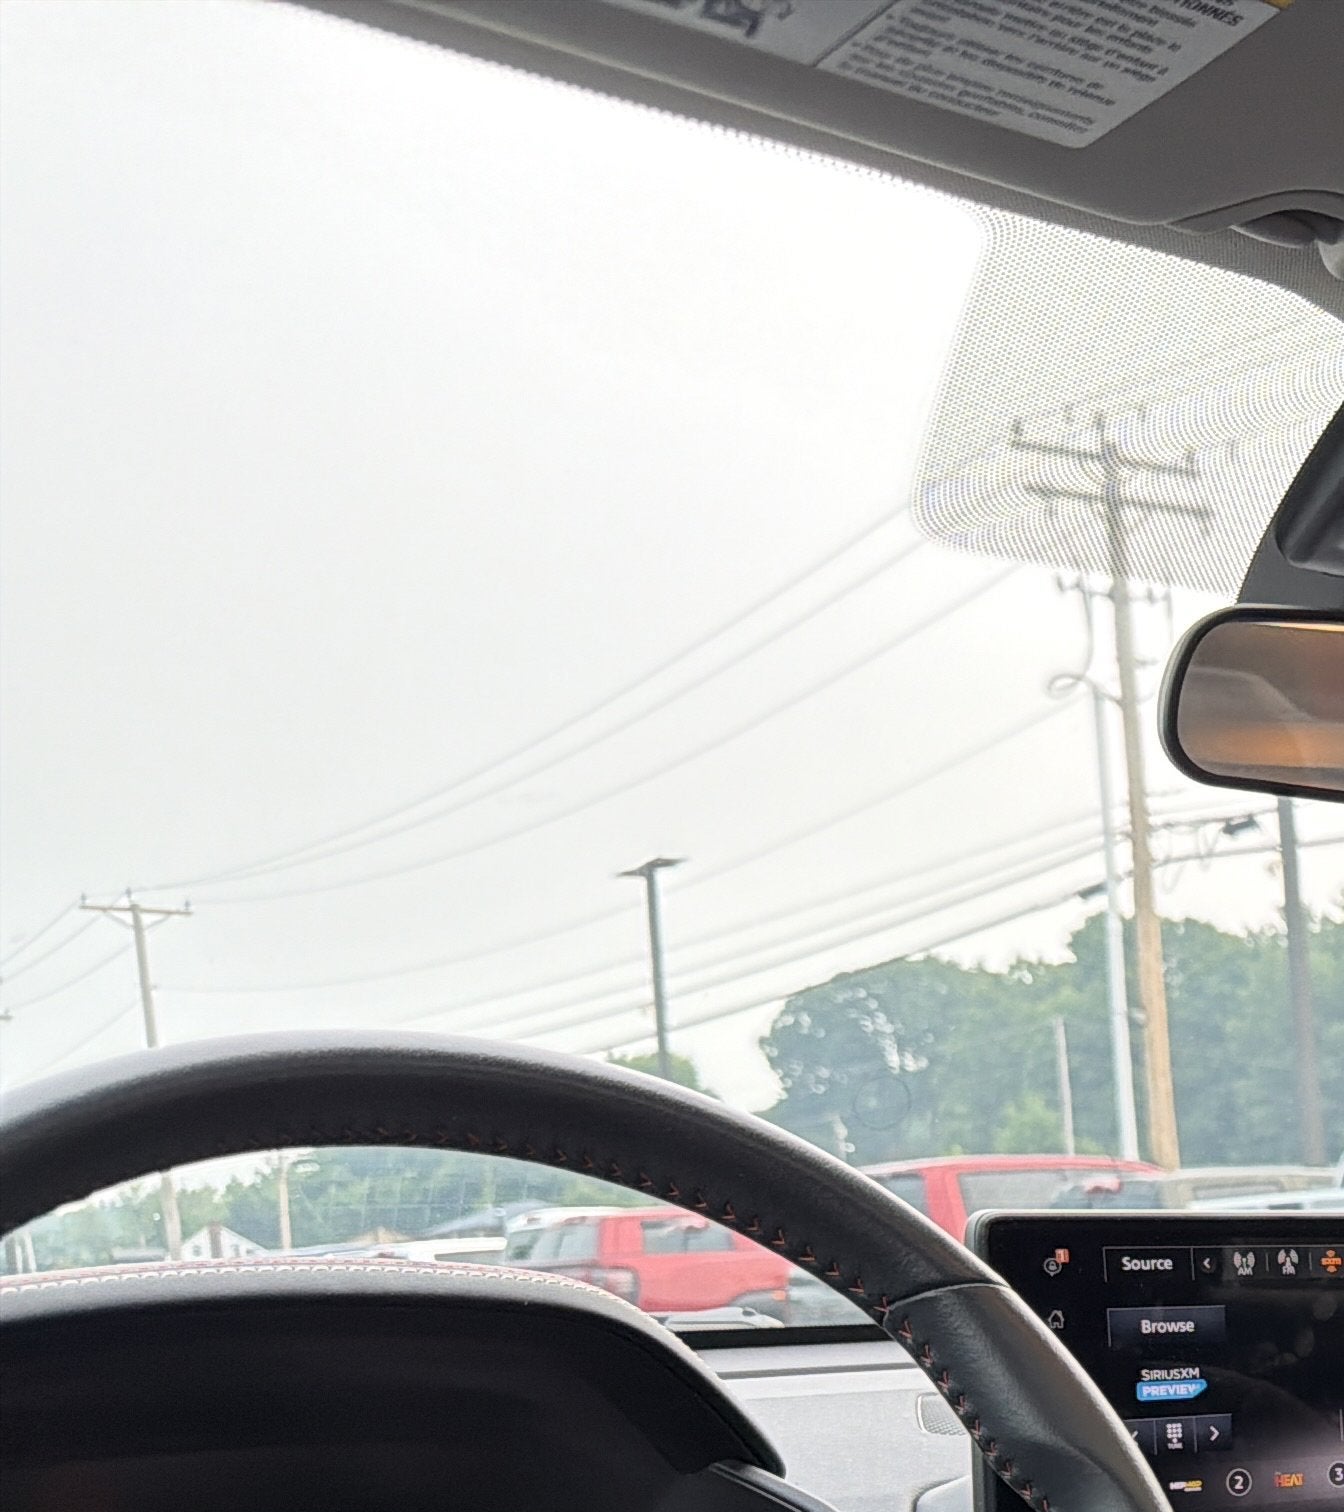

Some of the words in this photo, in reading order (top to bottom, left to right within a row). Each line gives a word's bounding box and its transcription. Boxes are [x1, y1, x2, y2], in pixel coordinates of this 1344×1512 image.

[1121, 1256, 1174, 1271] Source
[1140, 1319, 1196, 1335] Browse
[1141, 1366, 1200, 1382] SIRIUSXM
[1275, 1472, 1304, 1488] HEAT
[1334, 1467, 1344, 1481] 3
[1234, 1476, 1244, 1490] 2
